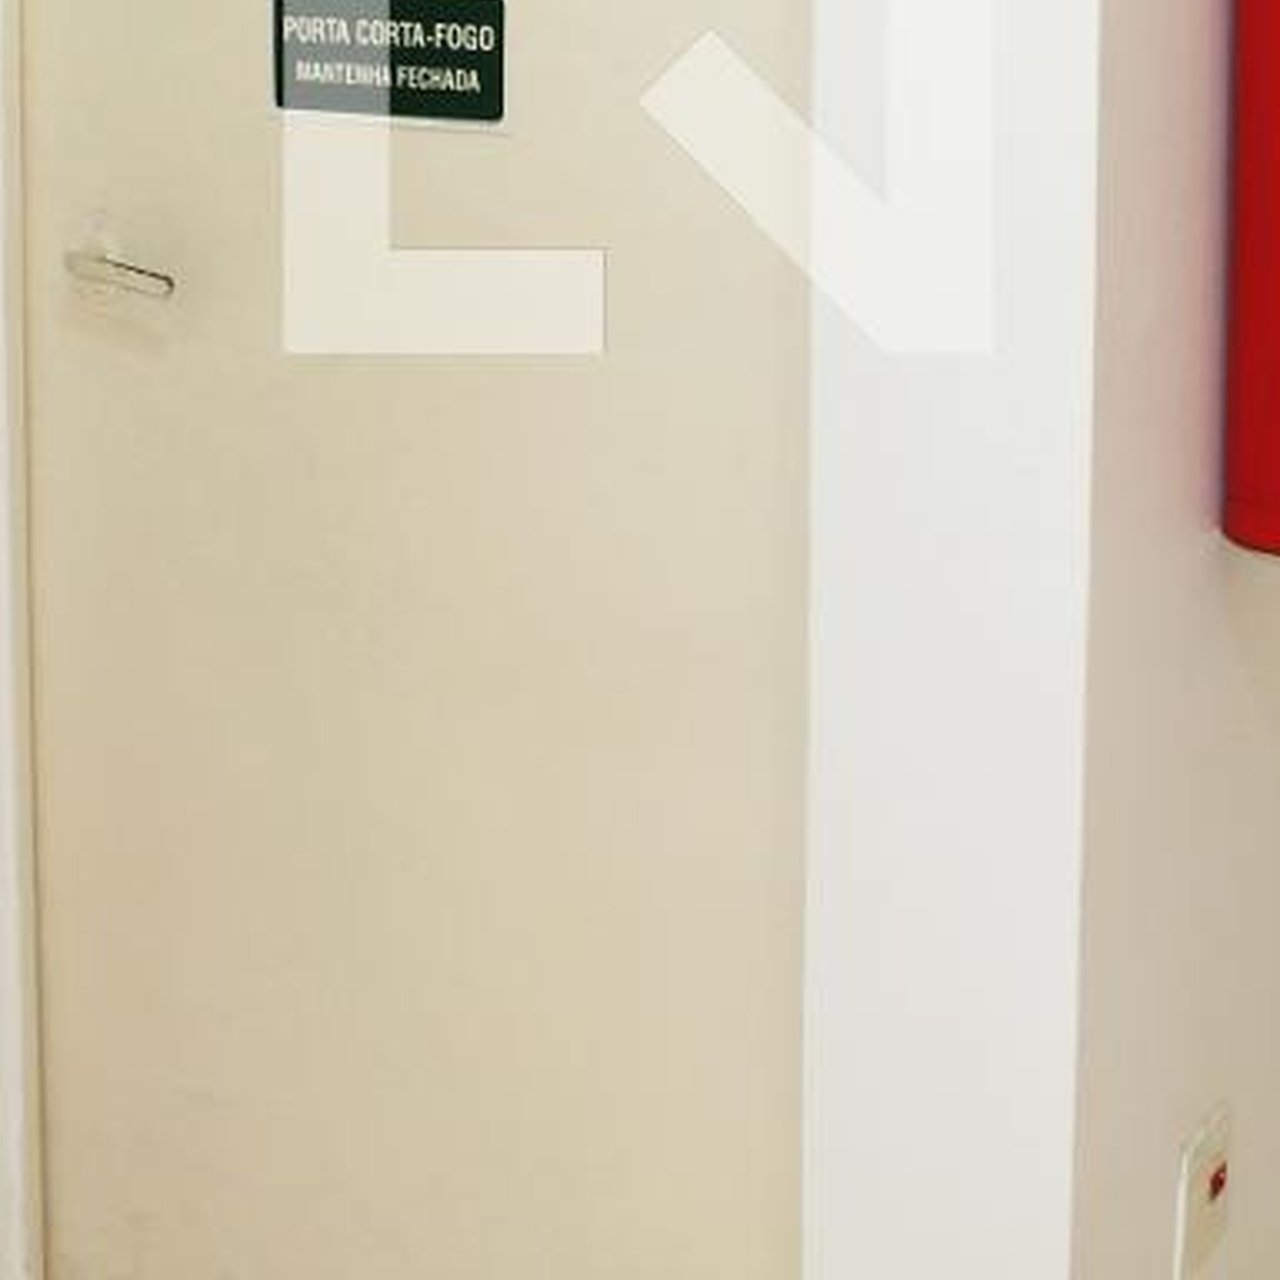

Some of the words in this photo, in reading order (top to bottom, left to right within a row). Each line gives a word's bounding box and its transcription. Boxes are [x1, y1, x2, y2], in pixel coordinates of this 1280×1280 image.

[282, 15, 352, 46] PORTA
[356, 18, 495, 52] CORTA-FOGO
[295, 60, 390, 88] MANTENHA
[396, 66, 482, 94] FECHADA
